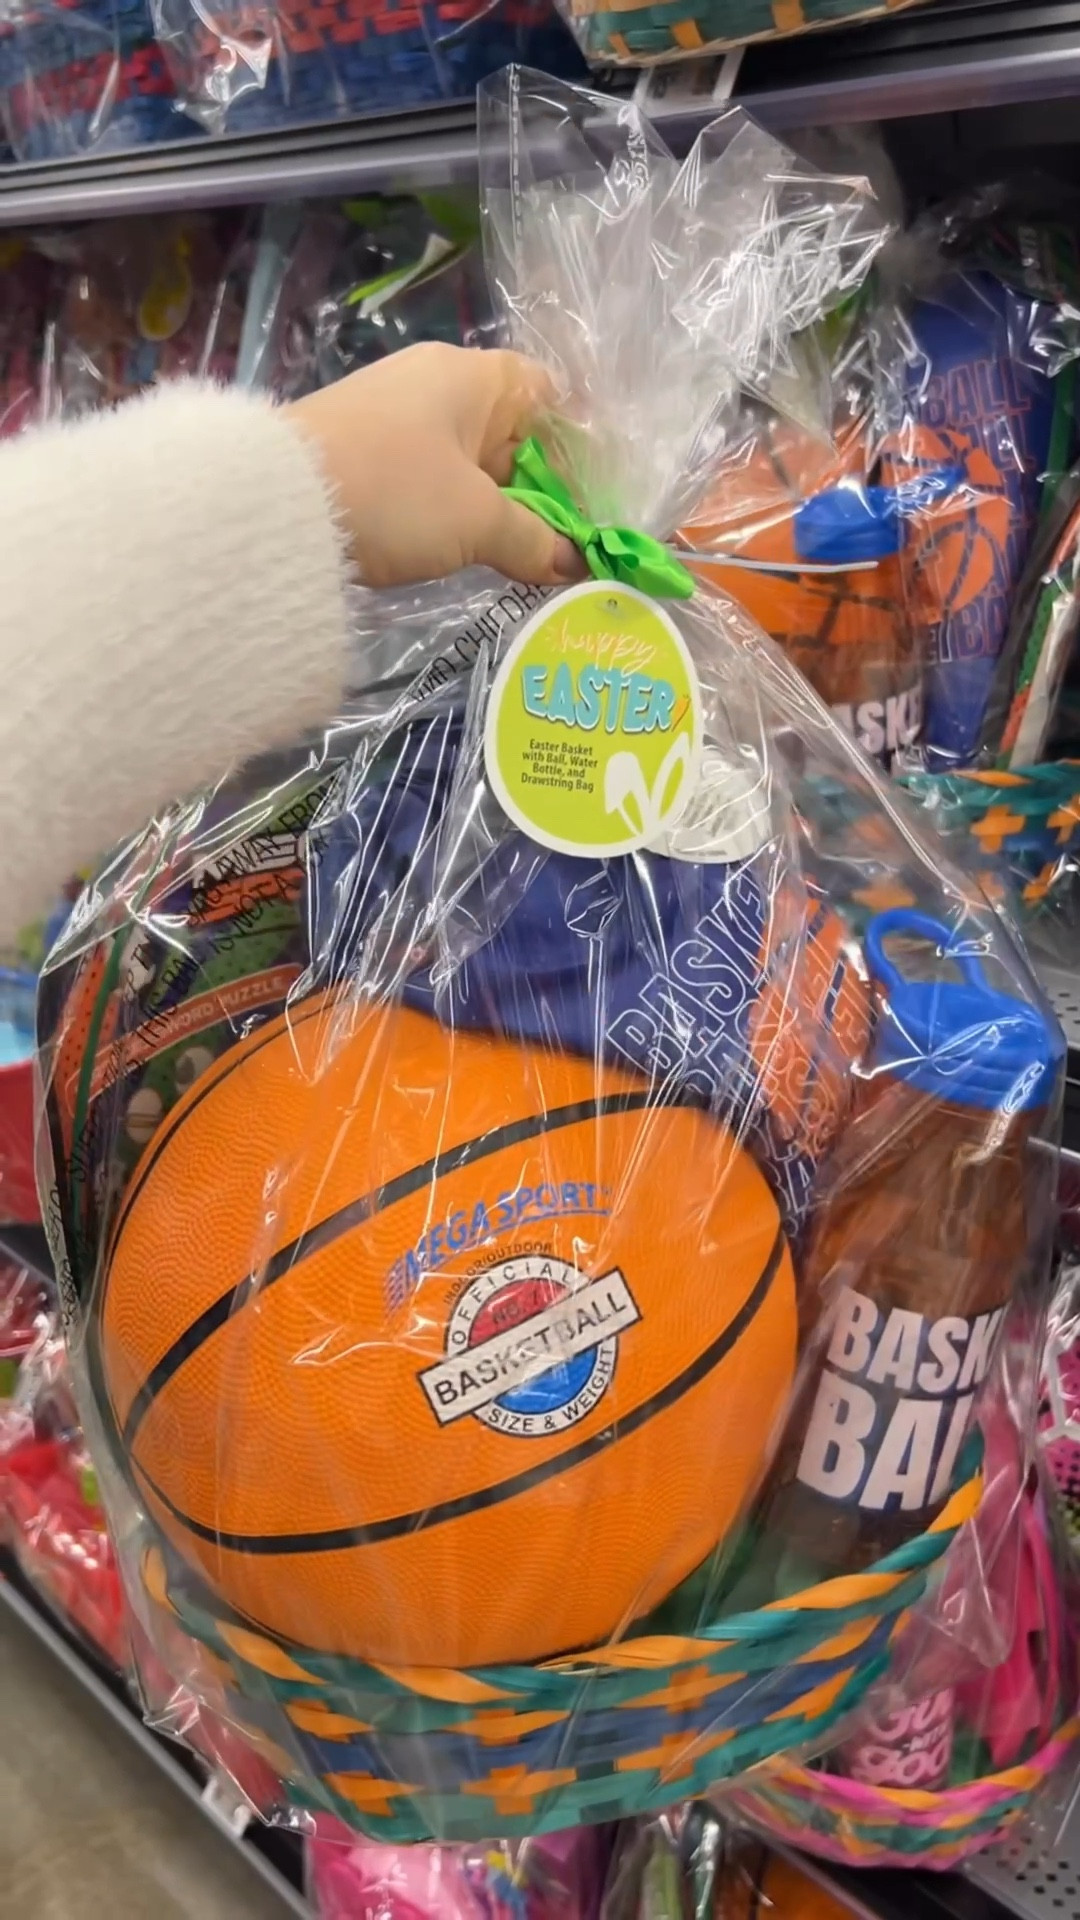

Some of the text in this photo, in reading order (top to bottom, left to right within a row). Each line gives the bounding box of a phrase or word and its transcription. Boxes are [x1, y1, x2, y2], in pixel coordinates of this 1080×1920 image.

[521, 662, 676, 733] EASTER
[521, 750, 598, 769] with Ball, Water
[529, 738, 593, 756] Easter Basket
[532, 761, 586, 778] Bottle, and
[520, 772, 594, 793] Drawstring Bag
[451, 1260, 572, 1346] OFFICIAL
[433, 1291, 628, 1406] BASKETBALL
[487, 1348, 614, 1433] SIZE & WEIGHT
